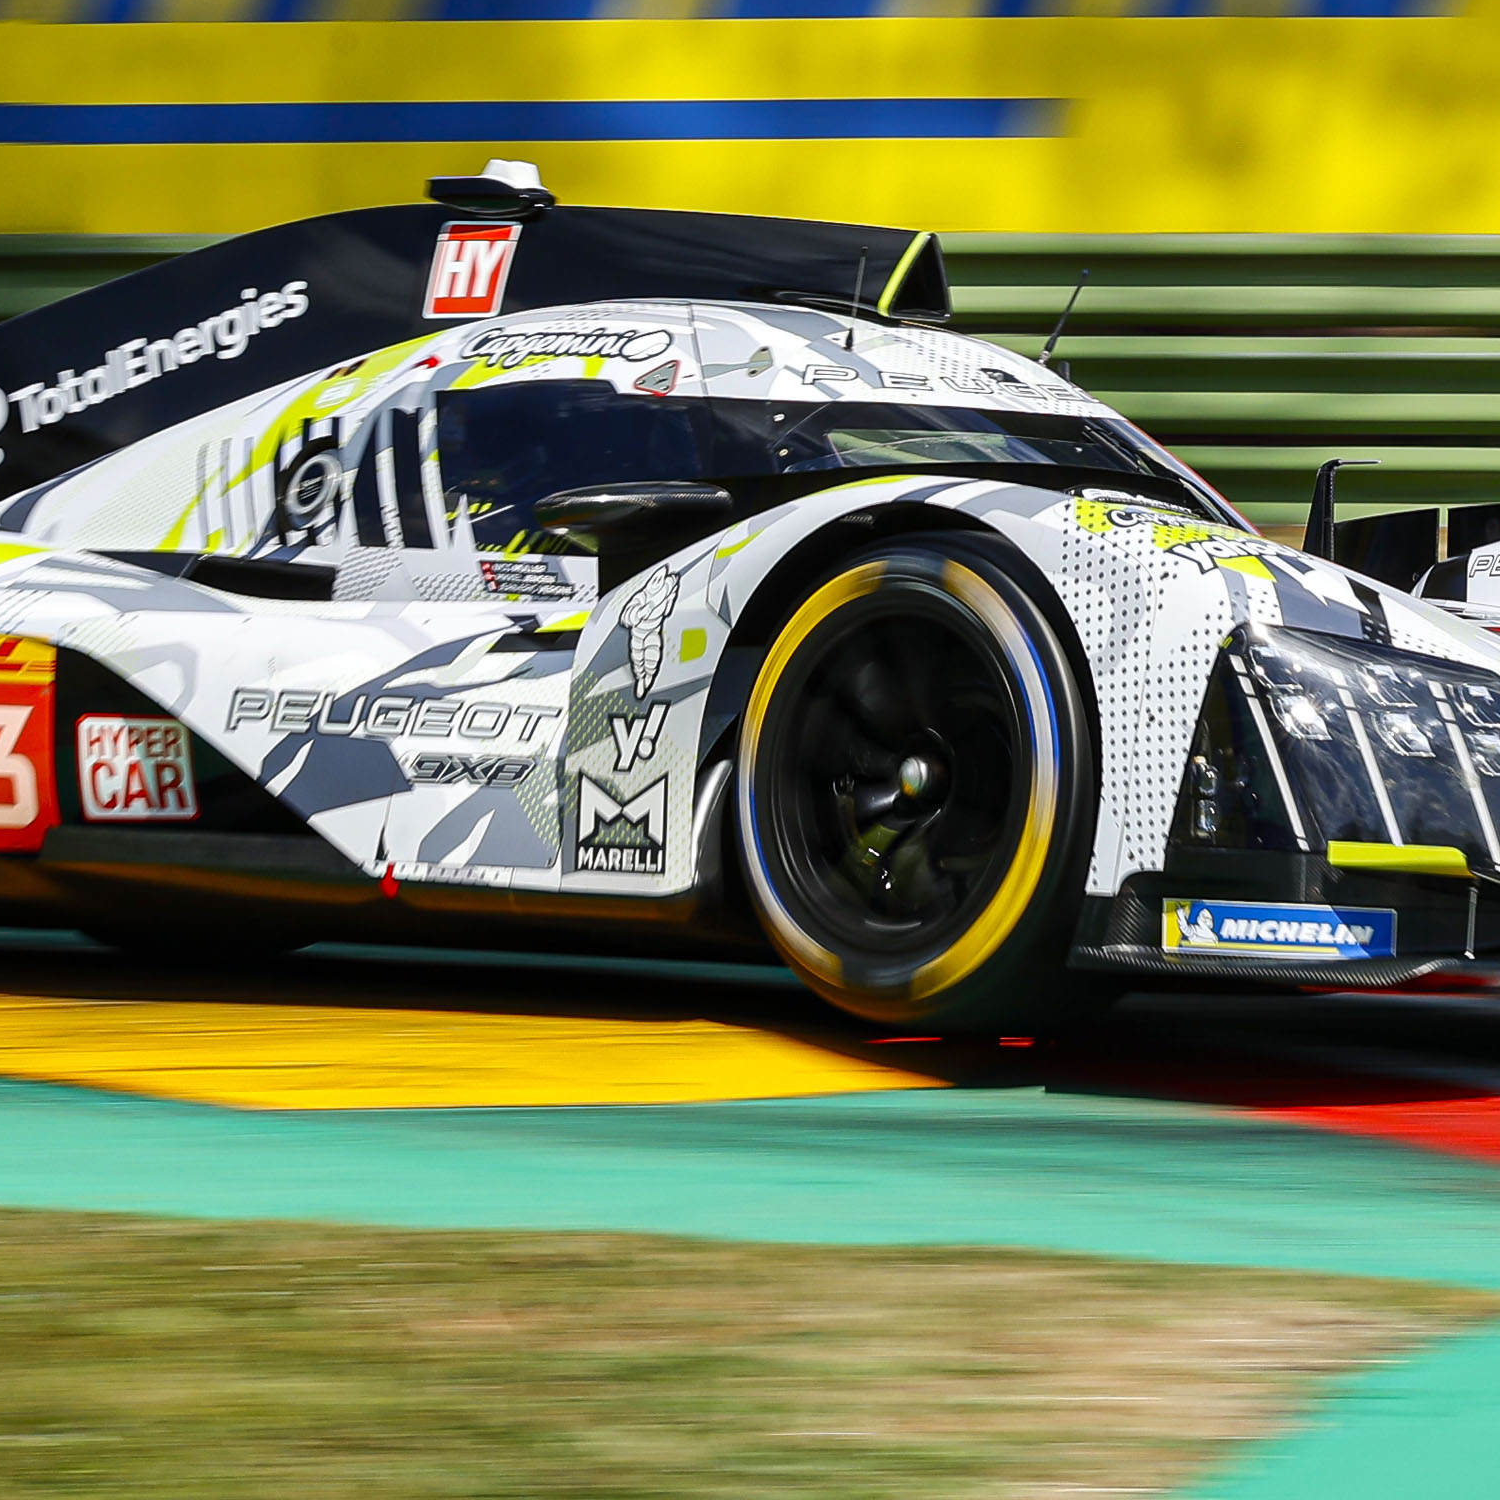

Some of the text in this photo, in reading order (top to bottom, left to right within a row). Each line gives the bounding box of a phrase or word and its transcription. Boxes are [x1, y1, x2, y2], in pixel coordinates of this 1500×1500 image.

[434, 241, 507, 299] HY
[8, 281, 309, 433] TotalEnergies
[461, 328, 636, 369] Capgemini
[802, 364, 1100, 403] PEUGE
[224, 687, 563, 742] PEUGEOT
[86, 724, 184, 758] HYPER
[90, 761, 190, 811] CAR
[410, 752, 536, 787] 9X8
[576, 845, 664, 873] MARELLI
[1220, 918, 1375, 946] MICHELIN
